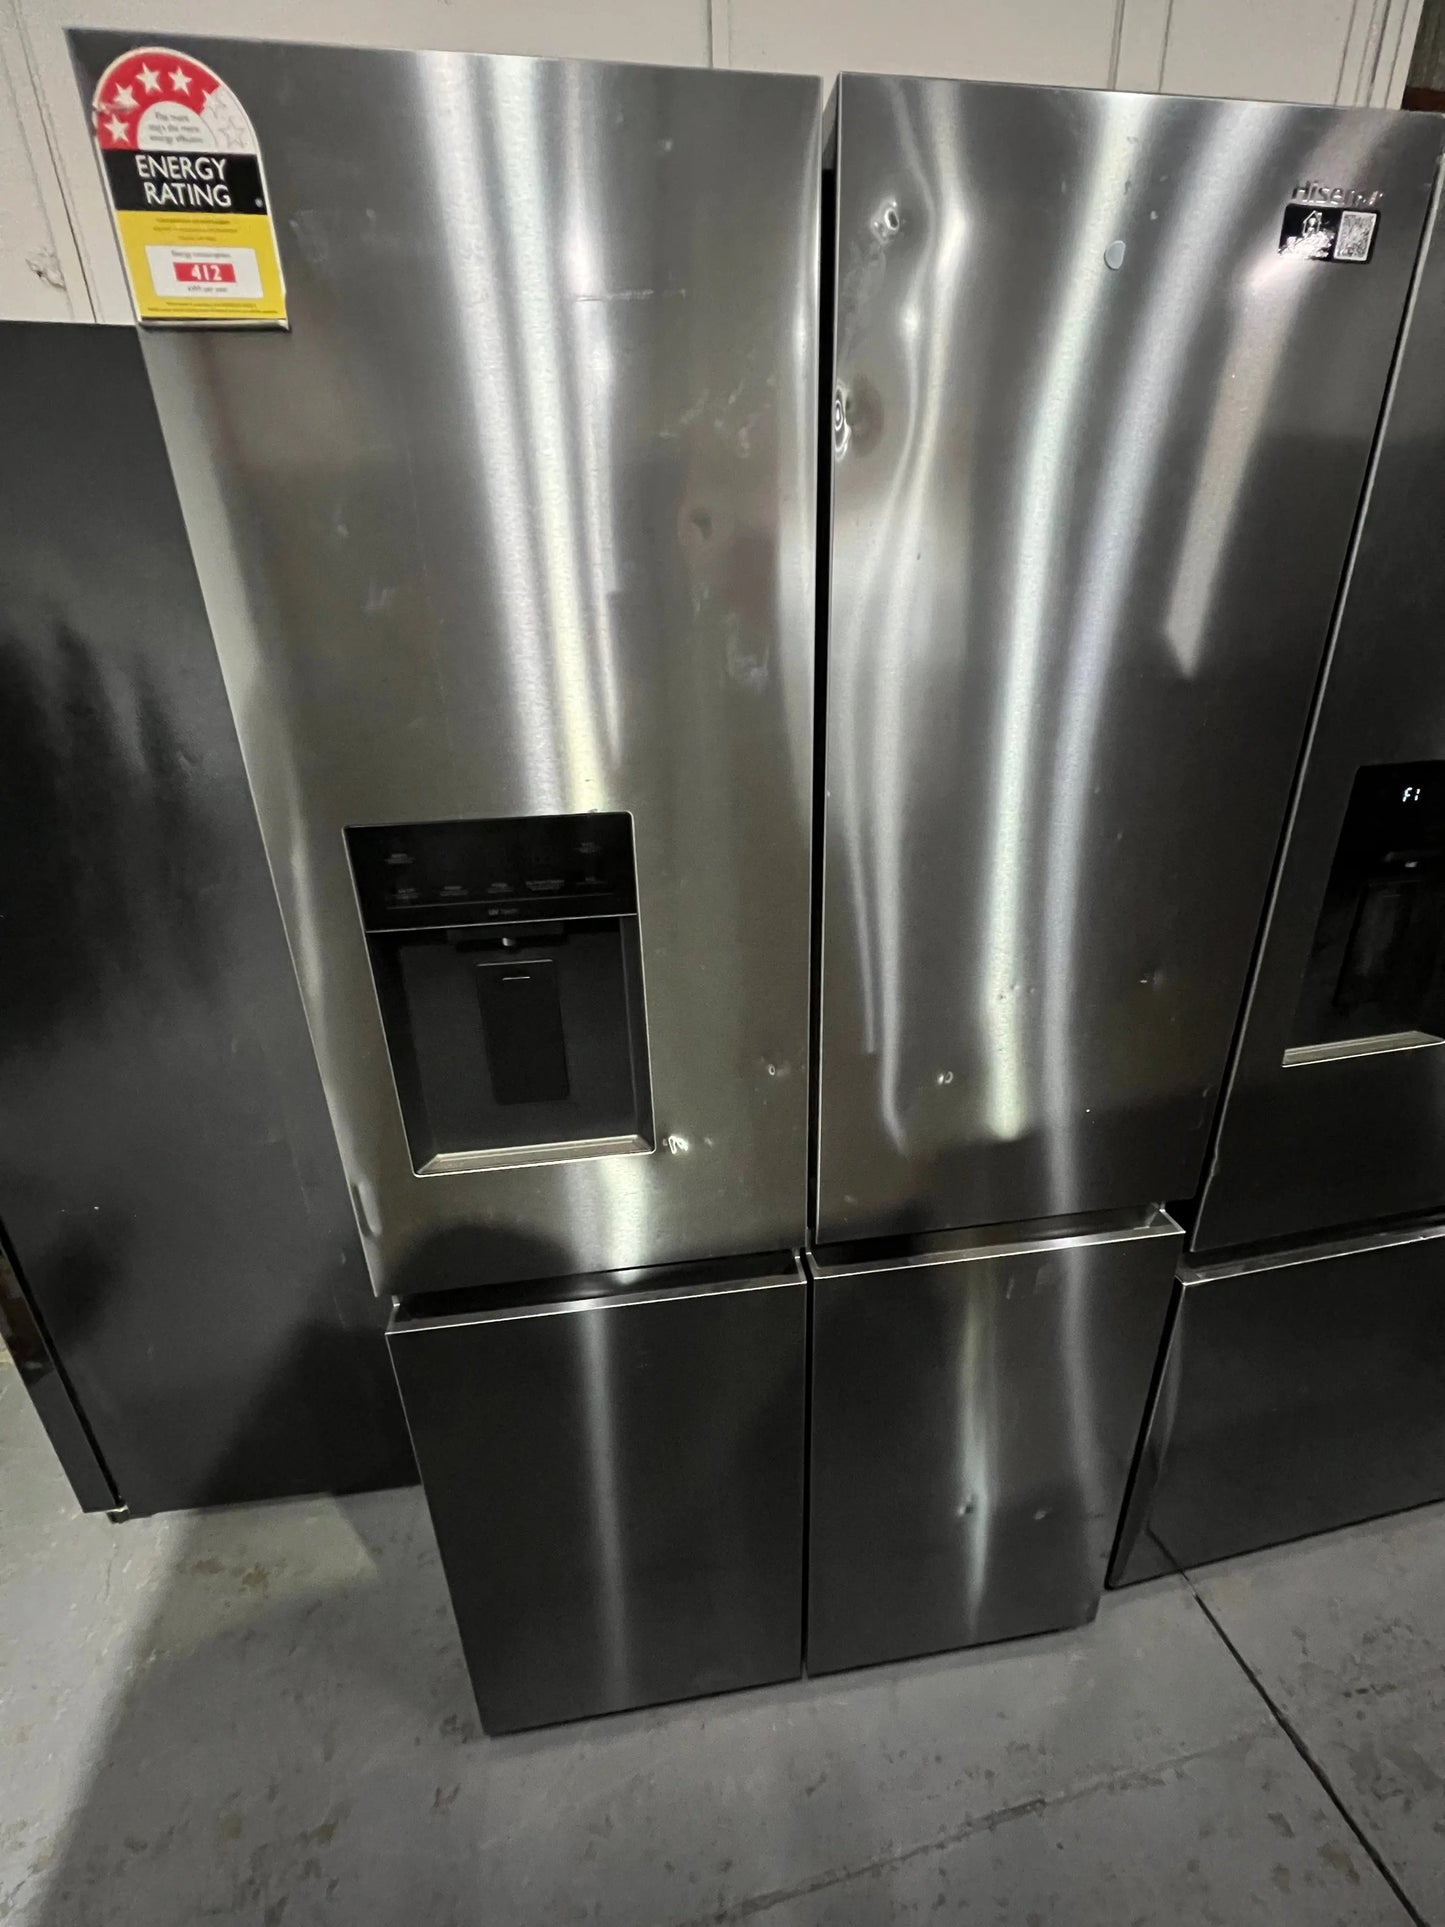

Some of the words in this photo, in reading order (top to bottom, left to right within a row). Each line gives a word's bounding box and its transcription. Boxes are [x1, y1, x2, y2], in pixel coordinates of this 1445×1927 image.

[135, 154, 227, 181] ENERGY
[143, 181, 232, 207] RATING
[191, 264, 223, 281] 412
